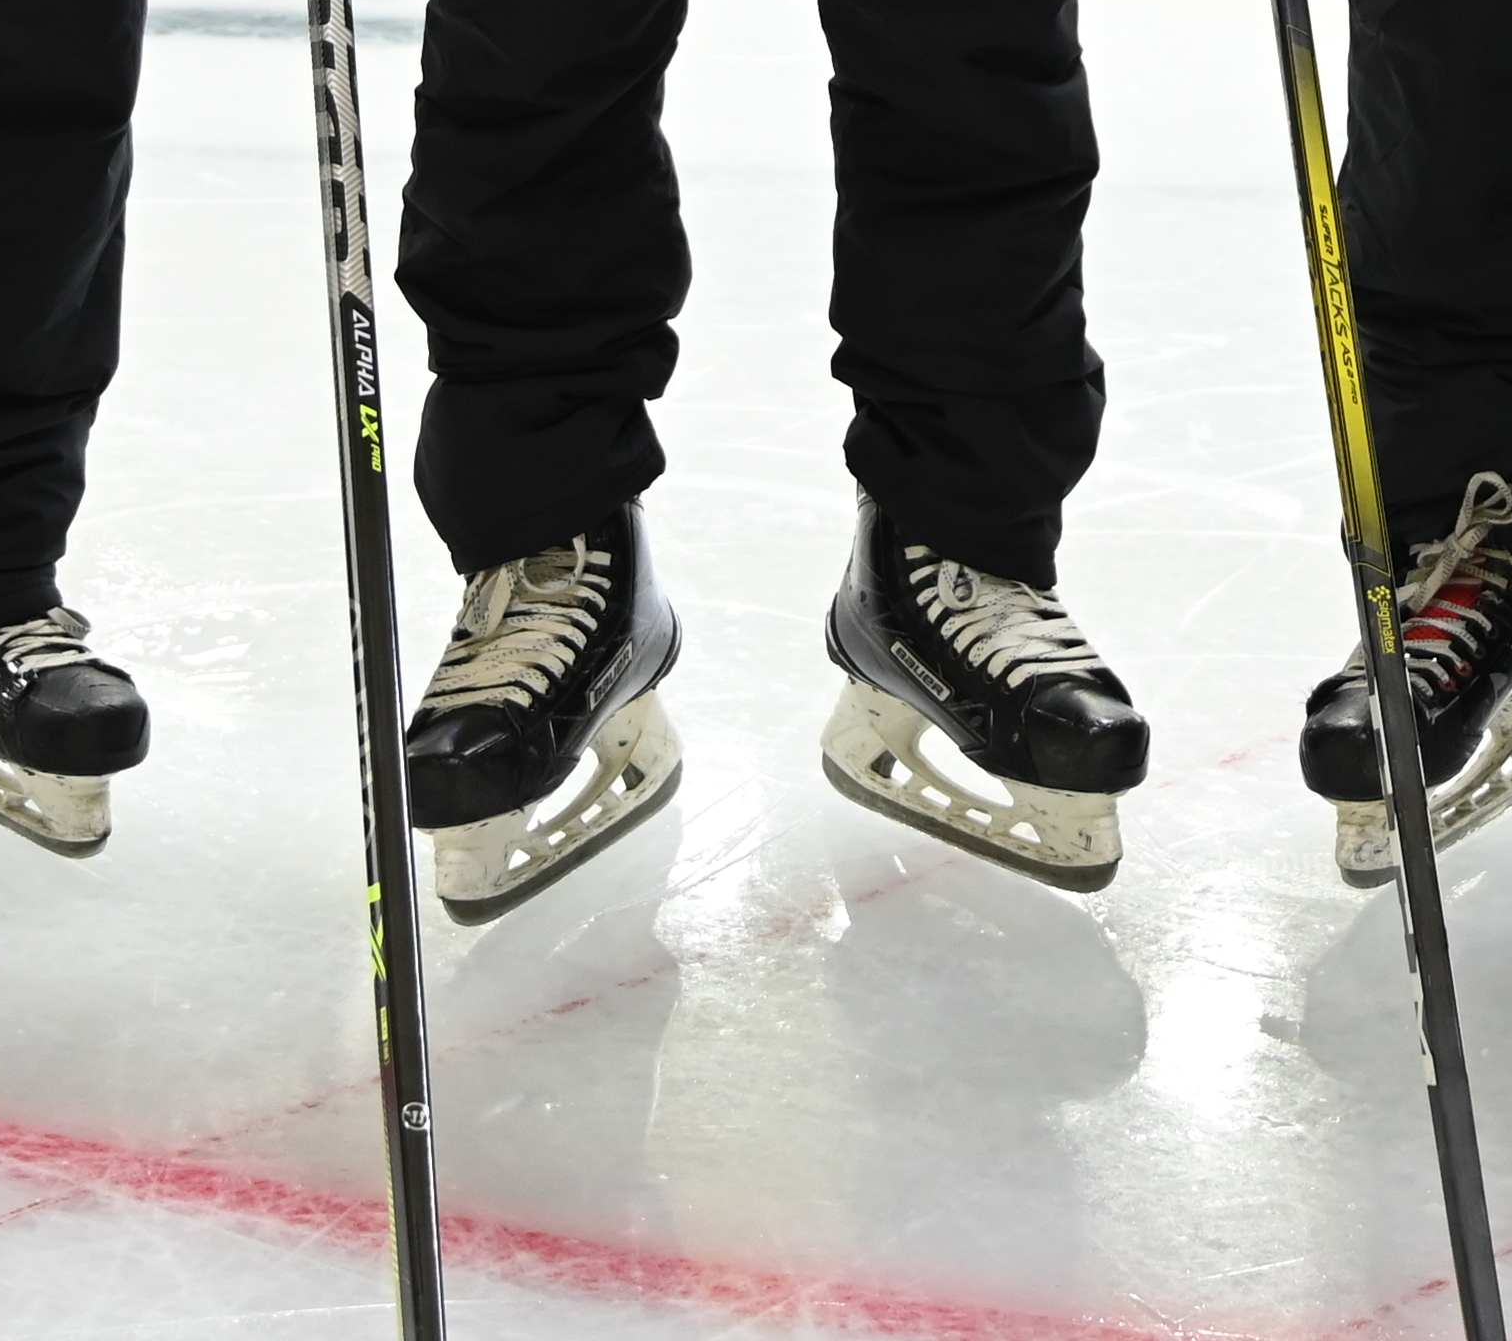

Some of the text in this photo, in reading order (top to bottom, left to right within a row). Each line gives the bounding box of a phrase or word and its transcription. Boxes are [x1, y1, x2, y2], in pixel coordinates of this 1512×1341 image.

[1318, 202, 1334, 257] SUPER
[1321, 255, 1351, 340] TACKS
[352, 307, 382, 473] ALPHA LX PRO
[1374, 599, 1398, 656] sigmatex
[593, 650, 631, 704] BAUER
[895, 647, 946, 697] BAUER
